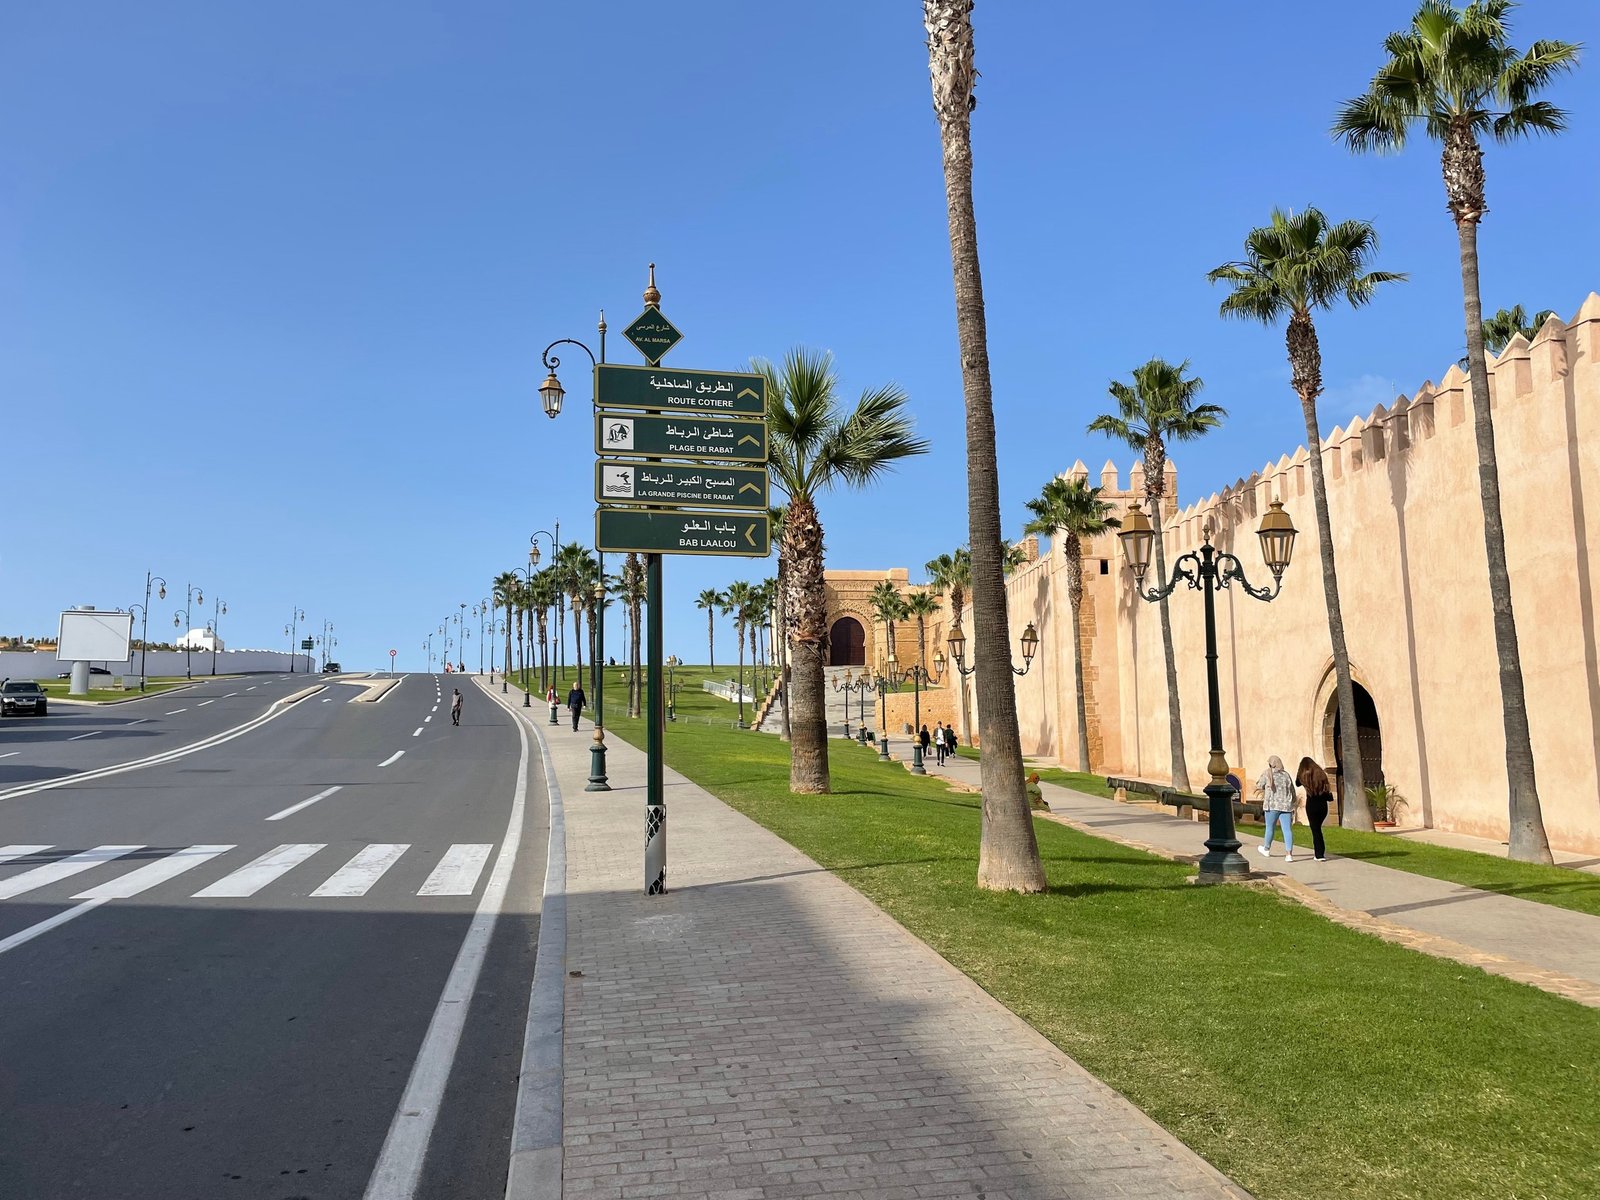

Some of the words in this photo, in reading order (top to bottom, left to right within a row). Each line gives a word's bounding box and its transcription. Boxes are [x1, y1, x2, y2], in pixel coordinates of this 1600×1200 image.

[650, 375, 692, 390] الساحلية
[696, 380, 734, 393] الطريق
[668, 396, 696, 406] ROUTE
[698, 398, 734, 408] COTIERE
[666, 424, 700, 438] الرباط
[703, 426, 734, 440] شاطئ
[669, 444, 695, 452] PLAGE
[641, 472, 673, 484] للرباط
[676, 475, 702, 487] الكبير
[706, 477, 735, 488] المسبح
[681, 520, 710, 533] العلو
[714, 522, 736, 534] باب
[679, 538, 698, 547] BAB
[700, 539, 736, 548] LAALOU
